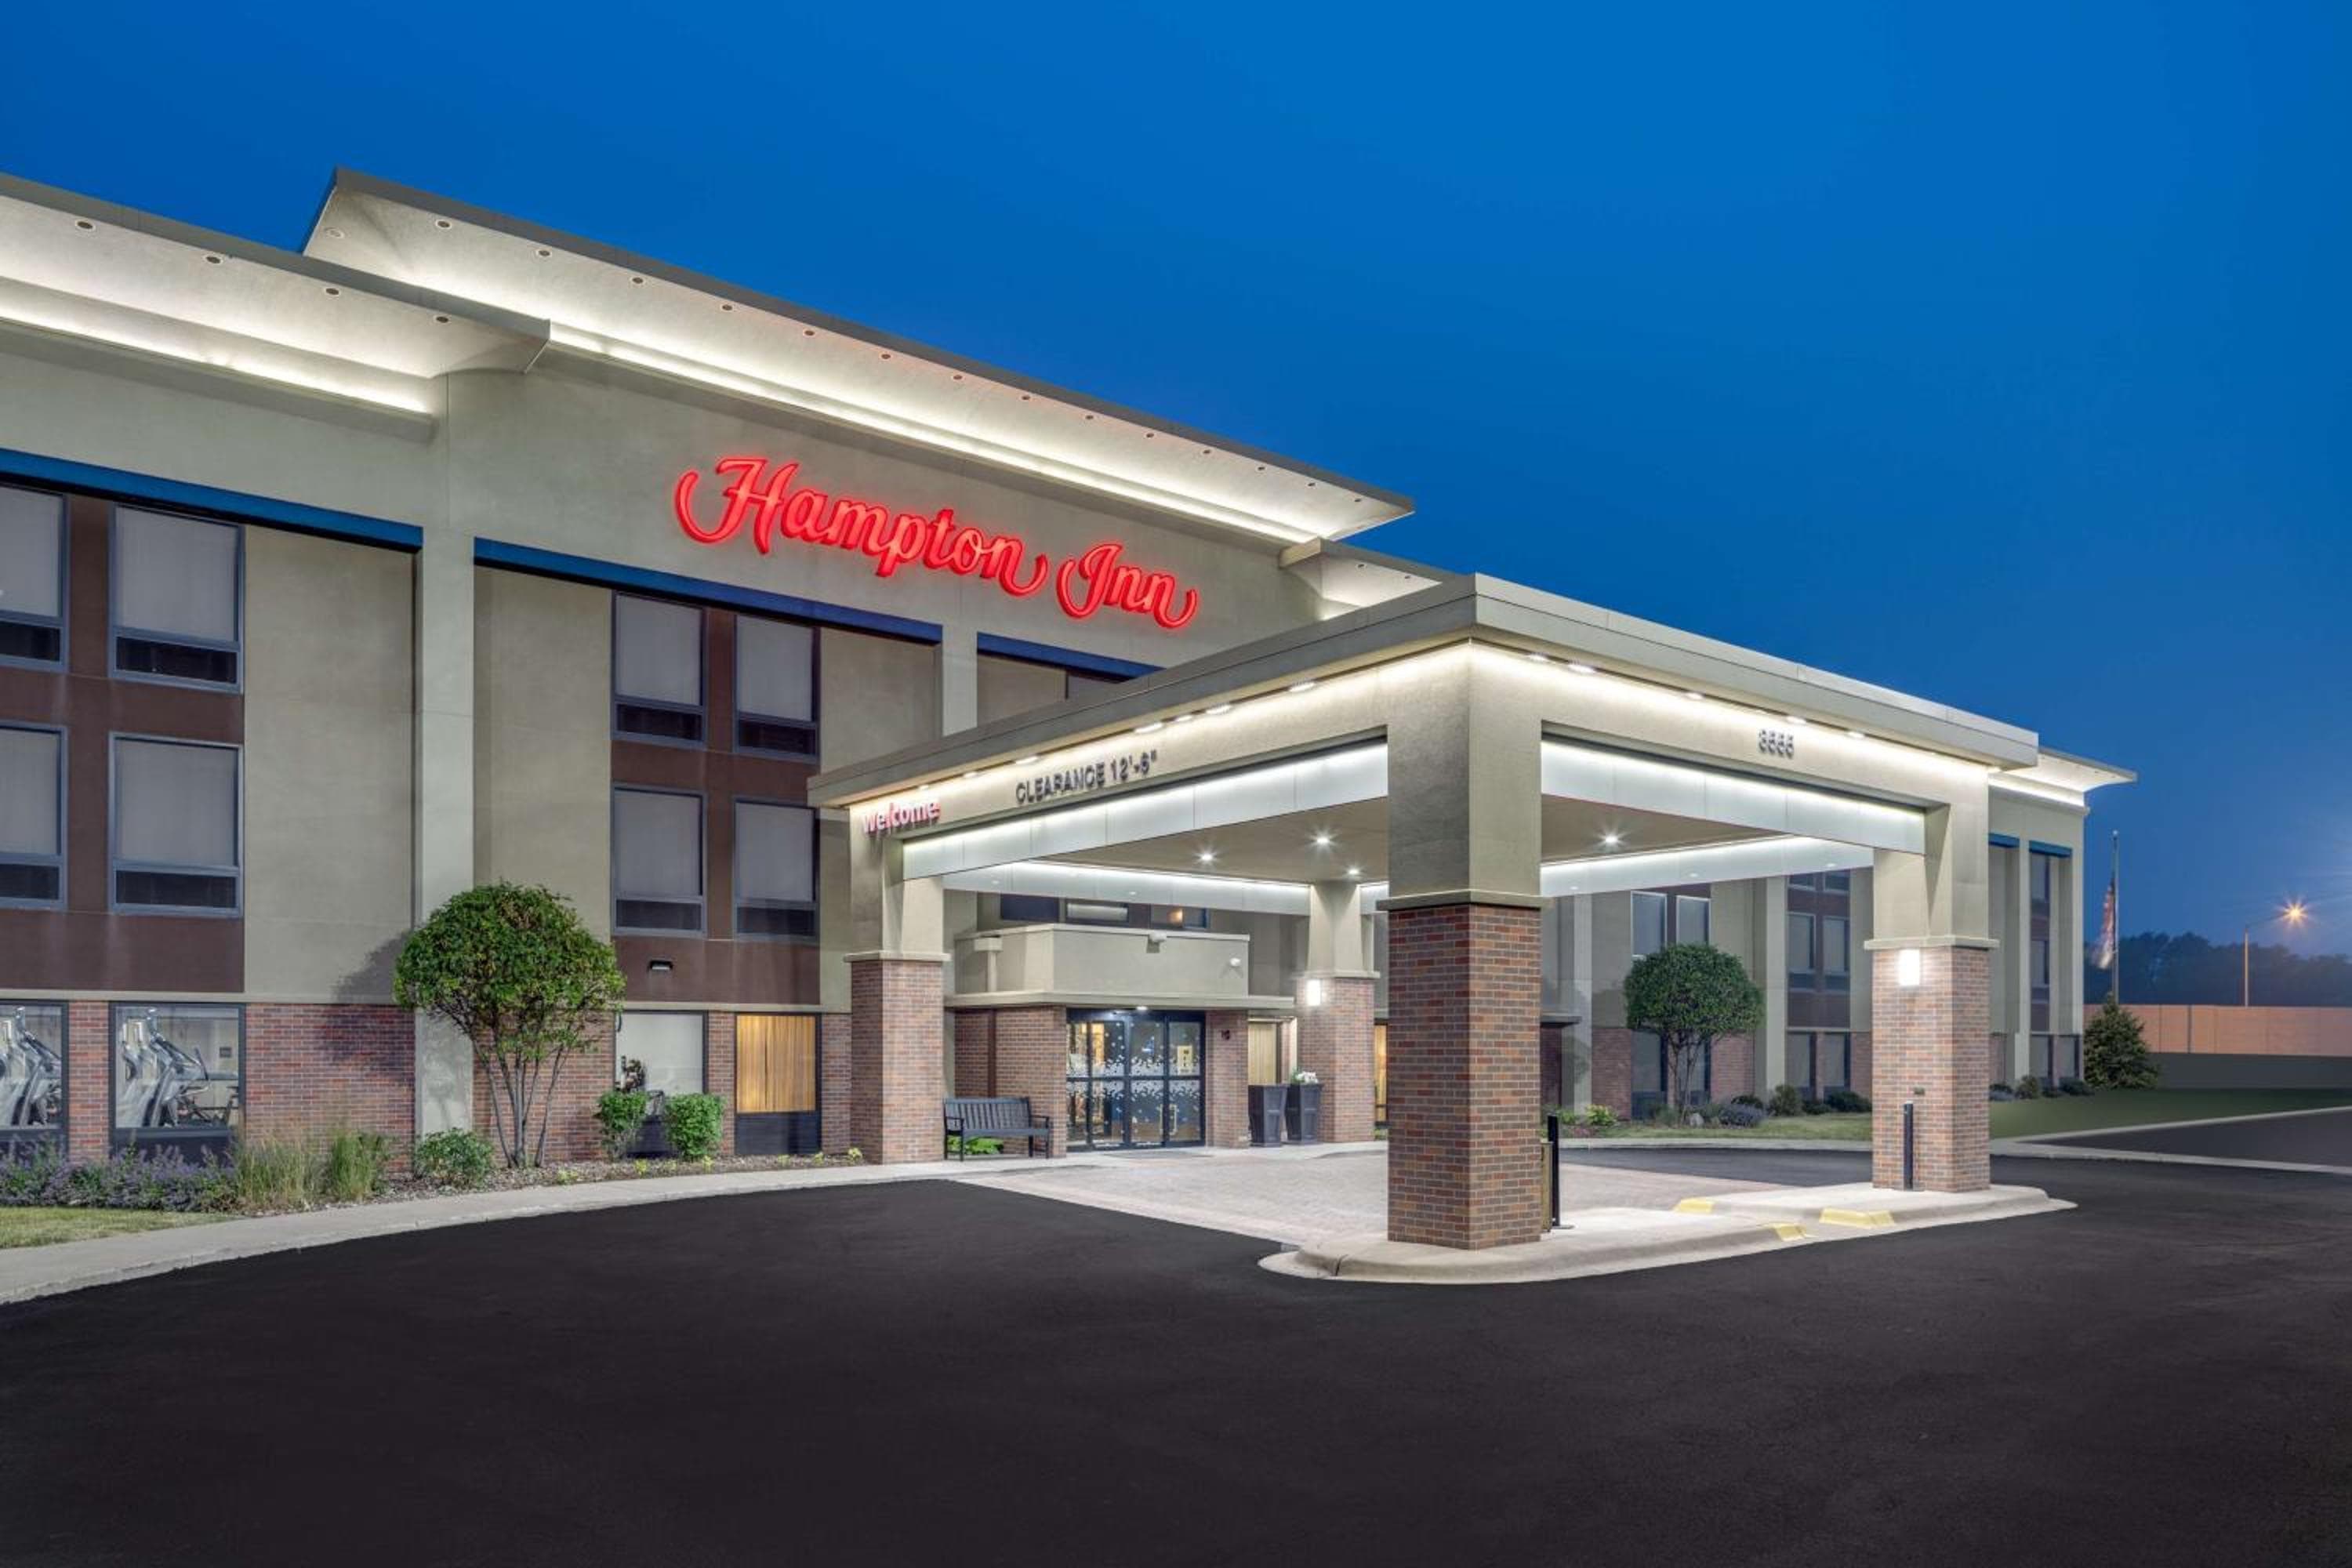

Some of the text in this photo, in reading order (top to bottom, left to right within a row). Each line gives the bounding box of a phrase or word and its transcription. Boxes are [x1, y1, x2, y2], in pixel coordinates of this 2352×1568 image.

[675, 458, 1198, 629] Hampton Inn
[1016, 762, 1105, 804] CLEARANCE
